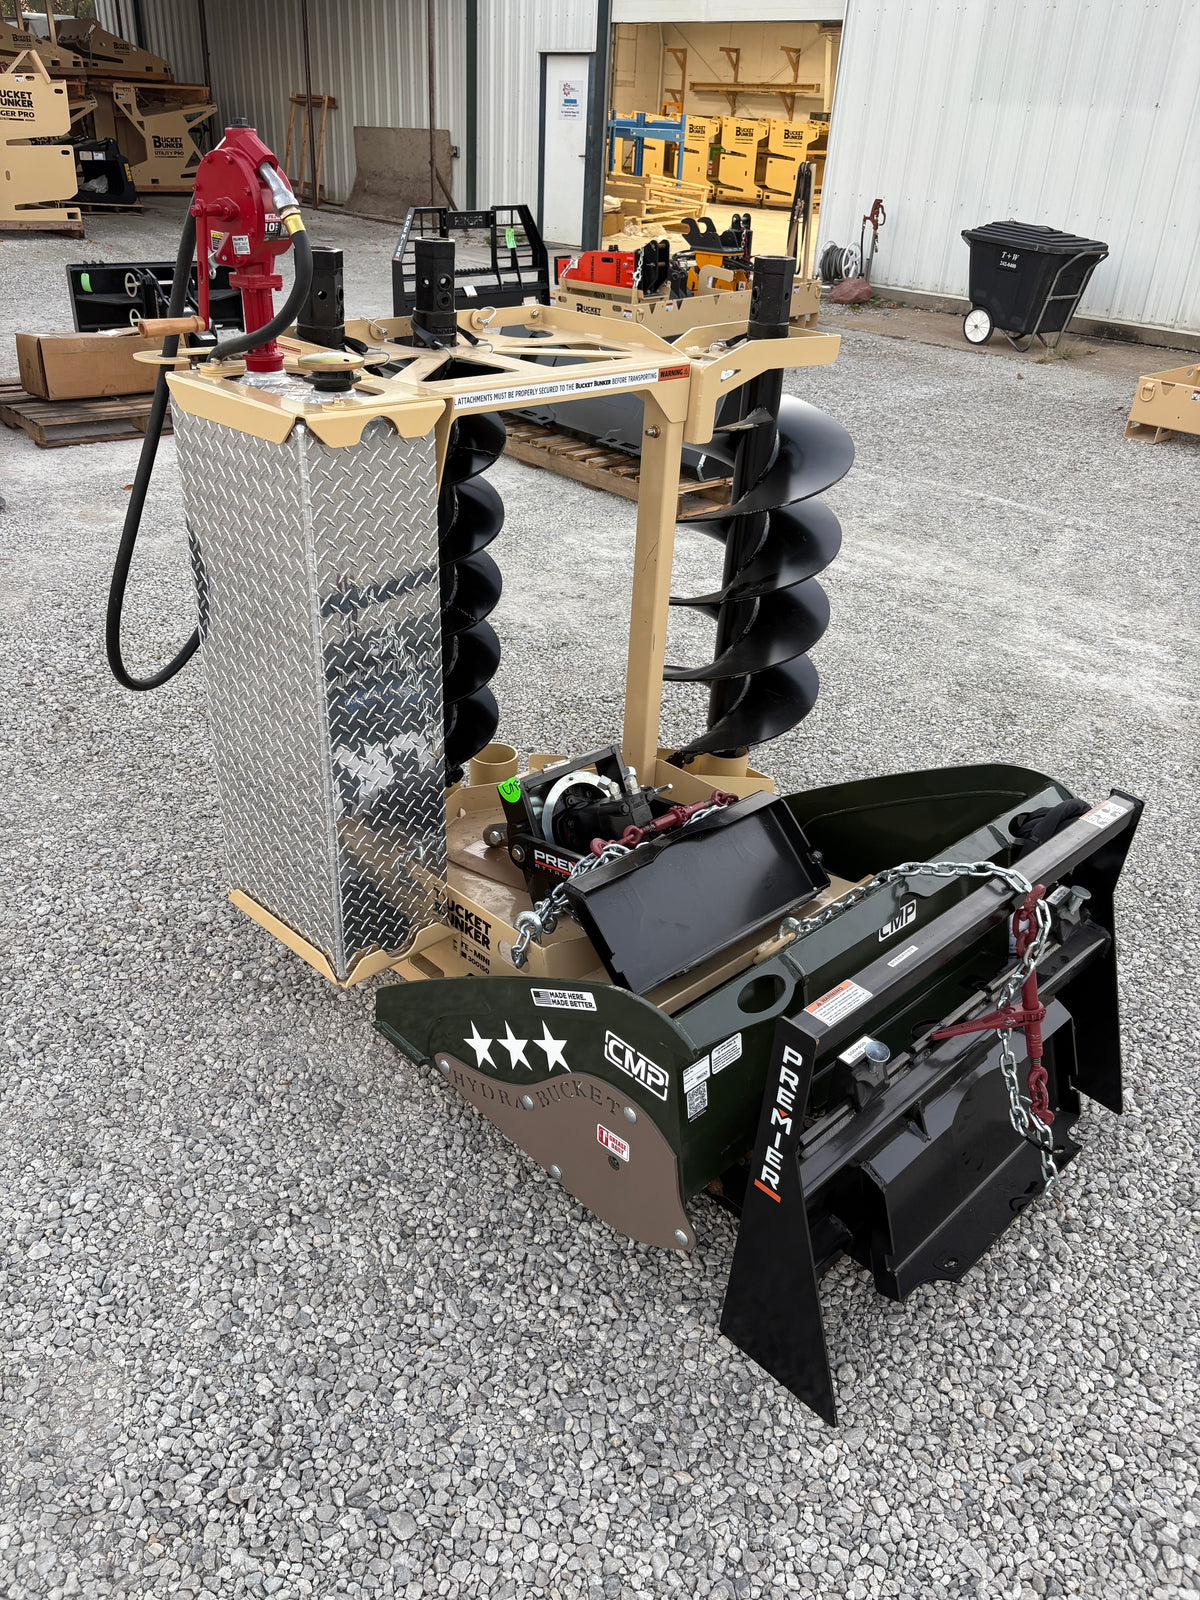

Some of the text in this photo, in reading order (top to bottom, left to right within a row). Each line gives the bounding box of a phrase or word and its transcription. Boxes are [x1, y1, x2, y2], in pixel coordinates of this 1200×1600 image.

[0, 90, 32, 100] UCKET
[0, 98, 34, 108] UNKER
[396, 214, 411, 258] PREMIER
[457, 394, 493, 405] ATTACHMENTS
[493, 392, 507, 401] MUST
[508, 391, 514, 399] BE
[515, 388, 538, 398] PROPERLY
[538, 386, 558, 395] SECURED
[559, 384, 565, 392] TO
[566, 383, 575, 391] THE
[575, 381, 593, 390] BUCKET
[594, 379, 611, 387] BUNKER
[612, 376, 627, 385] BEFORE
[628, 372, 657, 383] TRANSPORTING
[660, 368, 683, 378] WARNING
[534, 850, 578, 873] PREM
[447, 900, 492, 935] UCKET
[448, 912, 491, 951] UNKER
[473, 949, 490, 967] MINI
[549, 991, 567, 999] MADE
[551, 999, 569, 1007] MADE
[821, 986, 844, 1003] WARNING
[608, 1039, 665, 1087] CMP
[452, 1070, 621, 1115] HYDRA BUCKET
[760, 1045, 803, 1191] PREMIER
